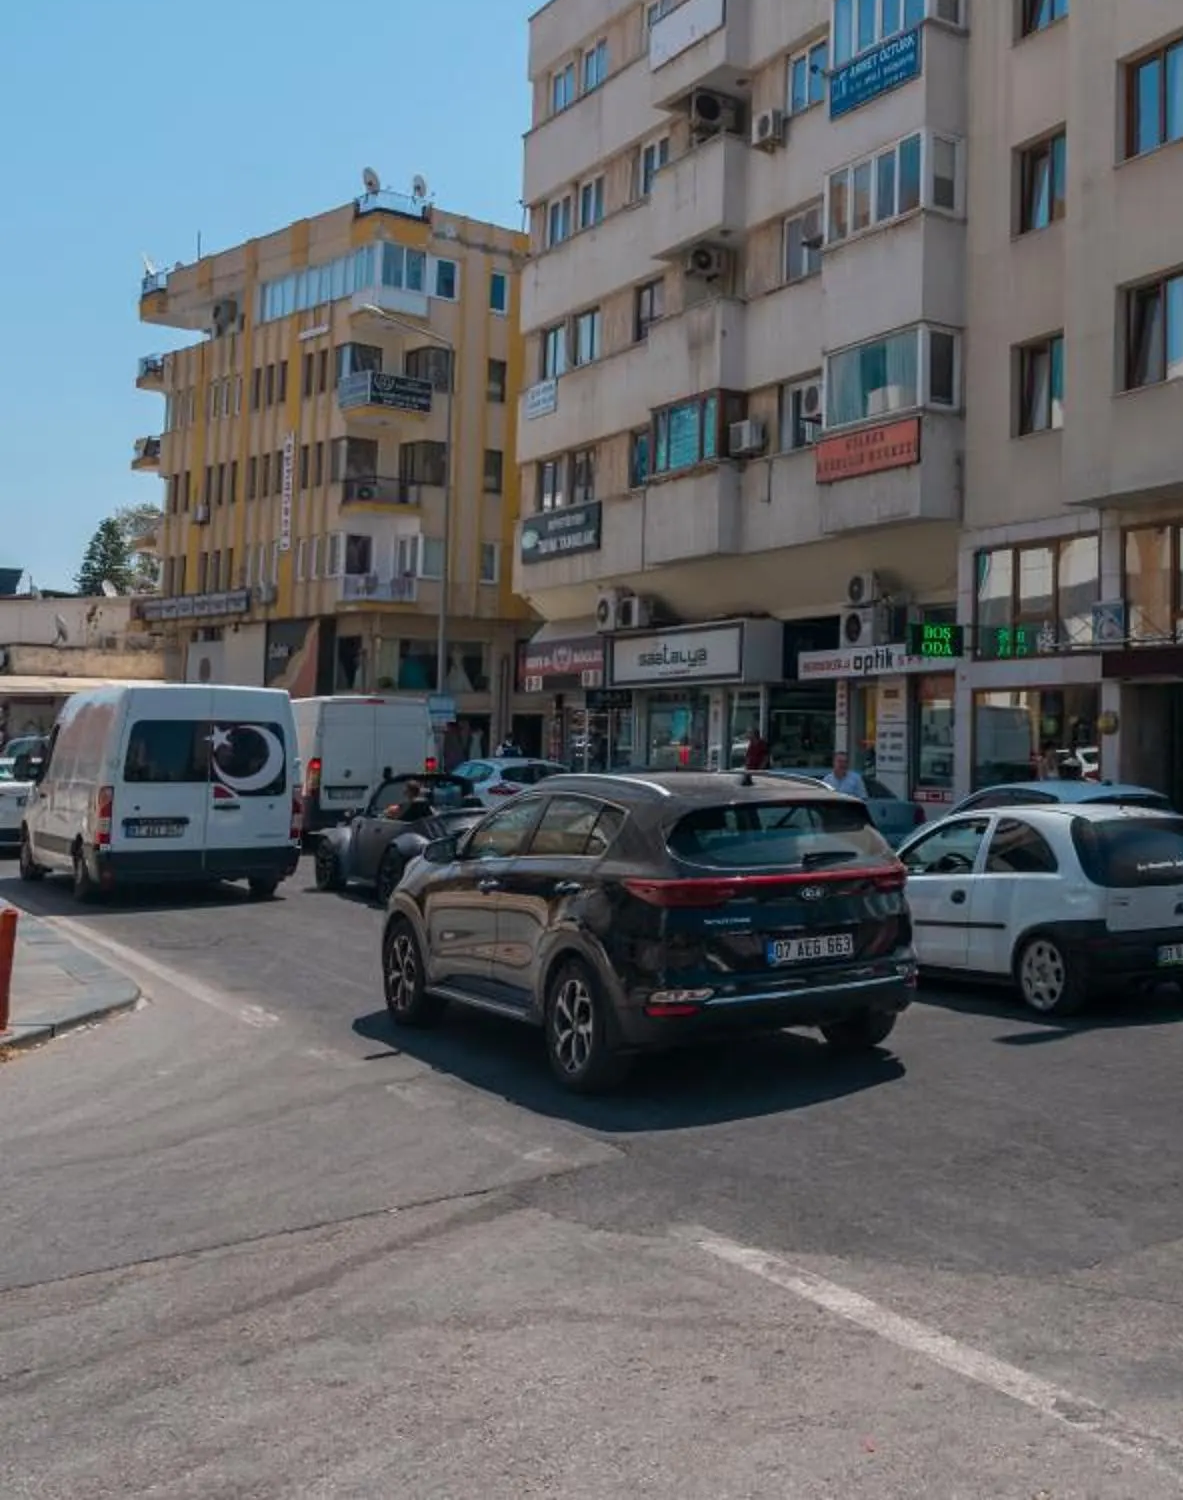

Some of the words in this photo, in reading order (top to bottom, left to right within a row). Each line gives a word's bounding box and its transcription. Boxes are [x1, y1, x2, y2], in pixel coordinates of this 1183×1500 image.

[921, 642, 952, 655] ODA
[853, 647, 894, 674] optik
[775, 941, 791, 959] 07
